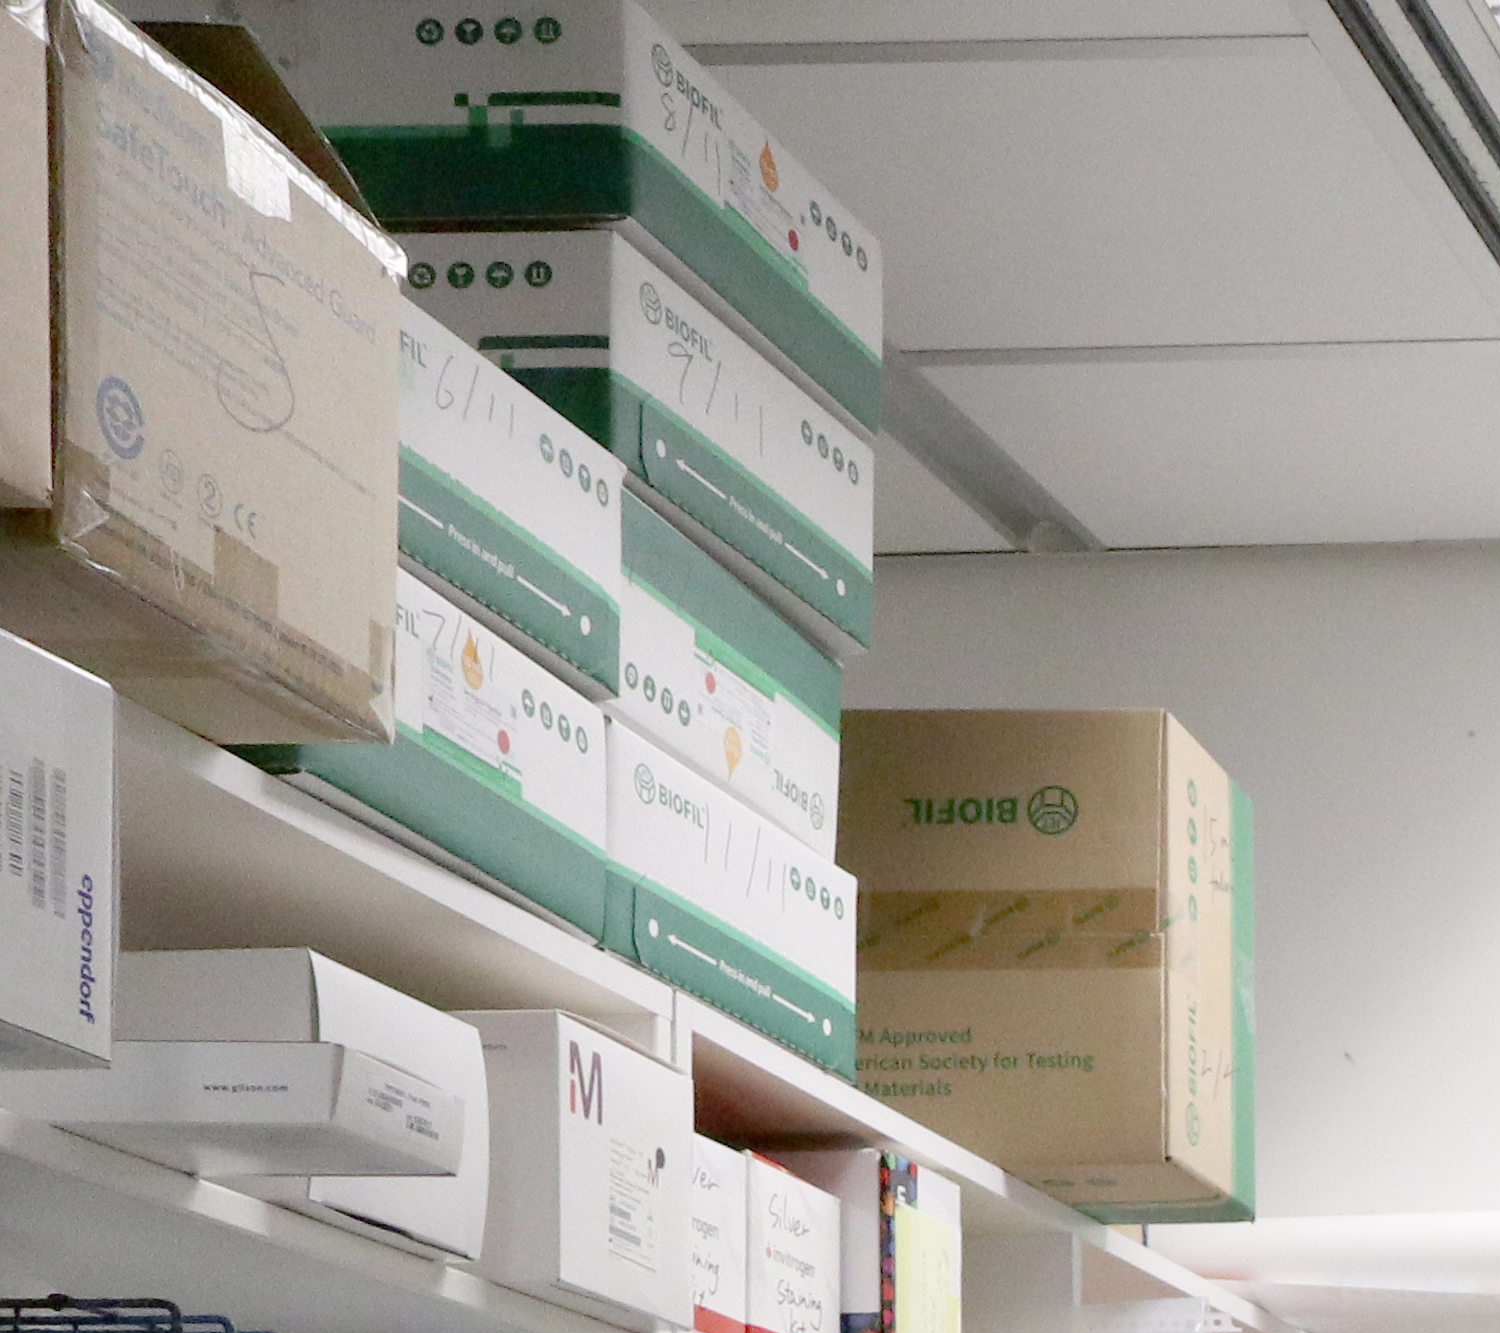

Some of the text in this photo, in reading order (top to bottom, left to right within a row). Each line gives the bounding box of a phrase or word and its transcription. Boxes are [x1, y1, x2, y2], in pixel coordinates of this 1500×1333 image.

[676, 71, 723, 131] BIOFIL
[664, 306, 712, 362] BIOFIL
[658, 784, 705, 830] BIOFIL
[774, 769, 809, 812] BIOFIL
[911, 798, 1018, 826] BIOFIL
[77, 872, 96, 1025] eppendorf
[880, 1027, 973, 1048] Approved
[919, 1052, 987, 1072] Society
[993, 1051, 1019, 1069] for
[1027, 1051, 1094, 1073] Testing
[203, 1083, 290, 1095] www.gilson.com
[864, 1079, 952, 1097] Materials
[768, 1193, 811, 1238] Silver
[773, 1247, 816, 1278] invitrogen
